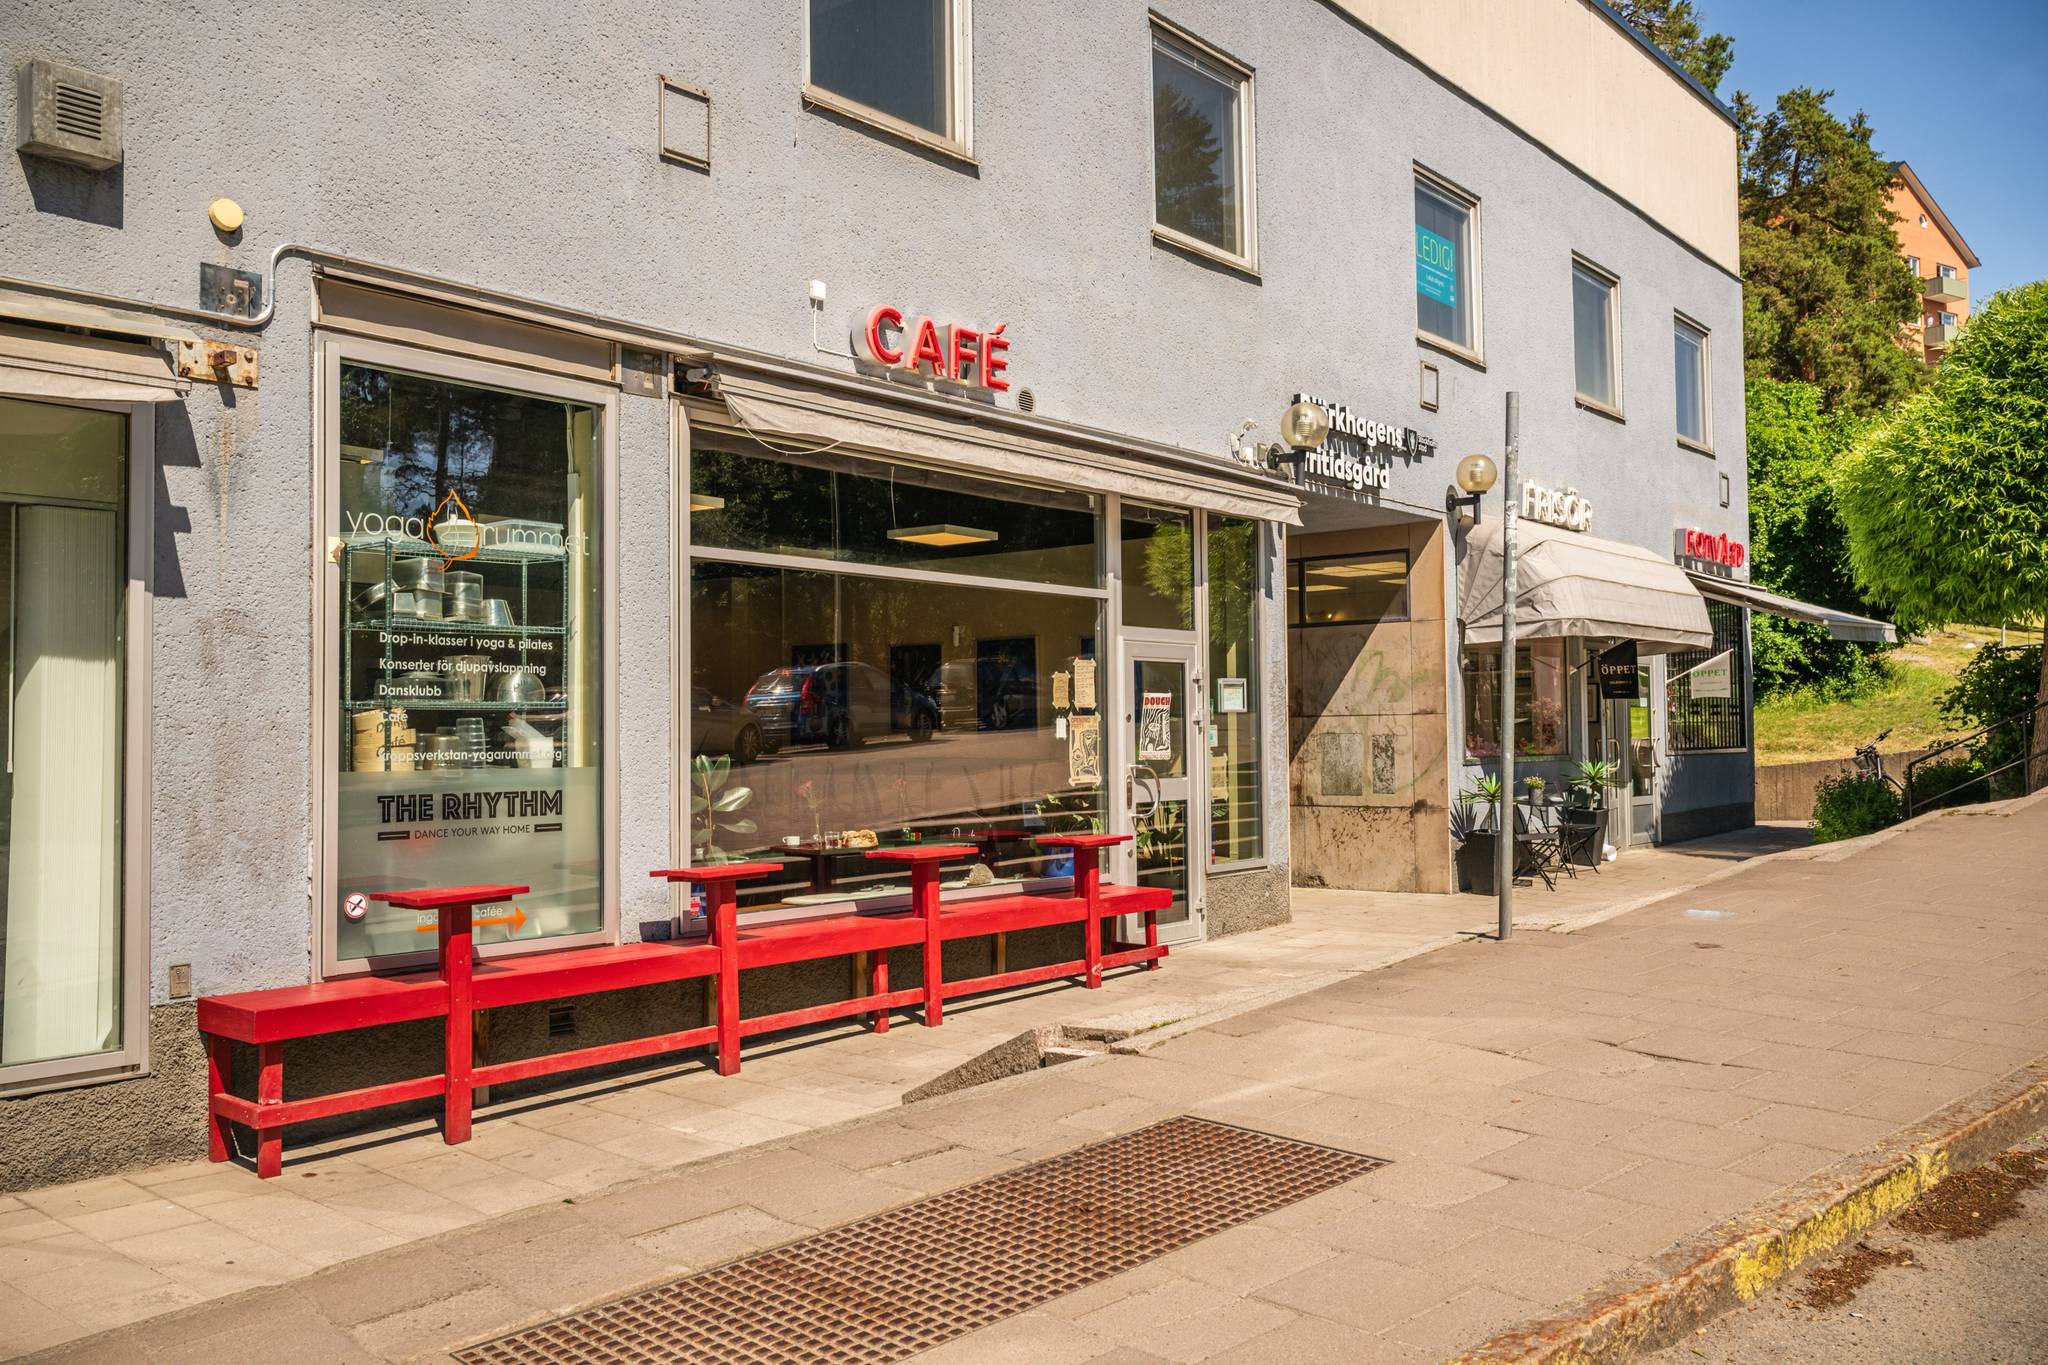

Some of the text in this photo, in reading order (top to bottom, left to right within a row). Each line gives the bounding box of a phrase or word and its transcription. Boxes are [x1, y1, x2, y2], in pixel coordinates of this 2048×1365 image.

[865, 303, 1011, 392] CAFÉ
[346, 510, 590, 556] yoga rummet
[379, 631, 468, 646] Drop-in-klasser
[476, 638, 505, 650] yoga
[507, 638, 516, 649] &
[518, 638, 553, 651] pilates
[379, 657, 547, 676] Konserter för djupavslappning
[1601, 664, 1636, 676] ÖPPET
[379, 684, 442, 698] Dansklubb
[382, 709, 408, 722] Café
[377, 790, 563, 824] THE RHYTHM
[414, 824, 531, 840] DANCE YOUR WAY HOME
[474, 906, 504, 919] cafée
